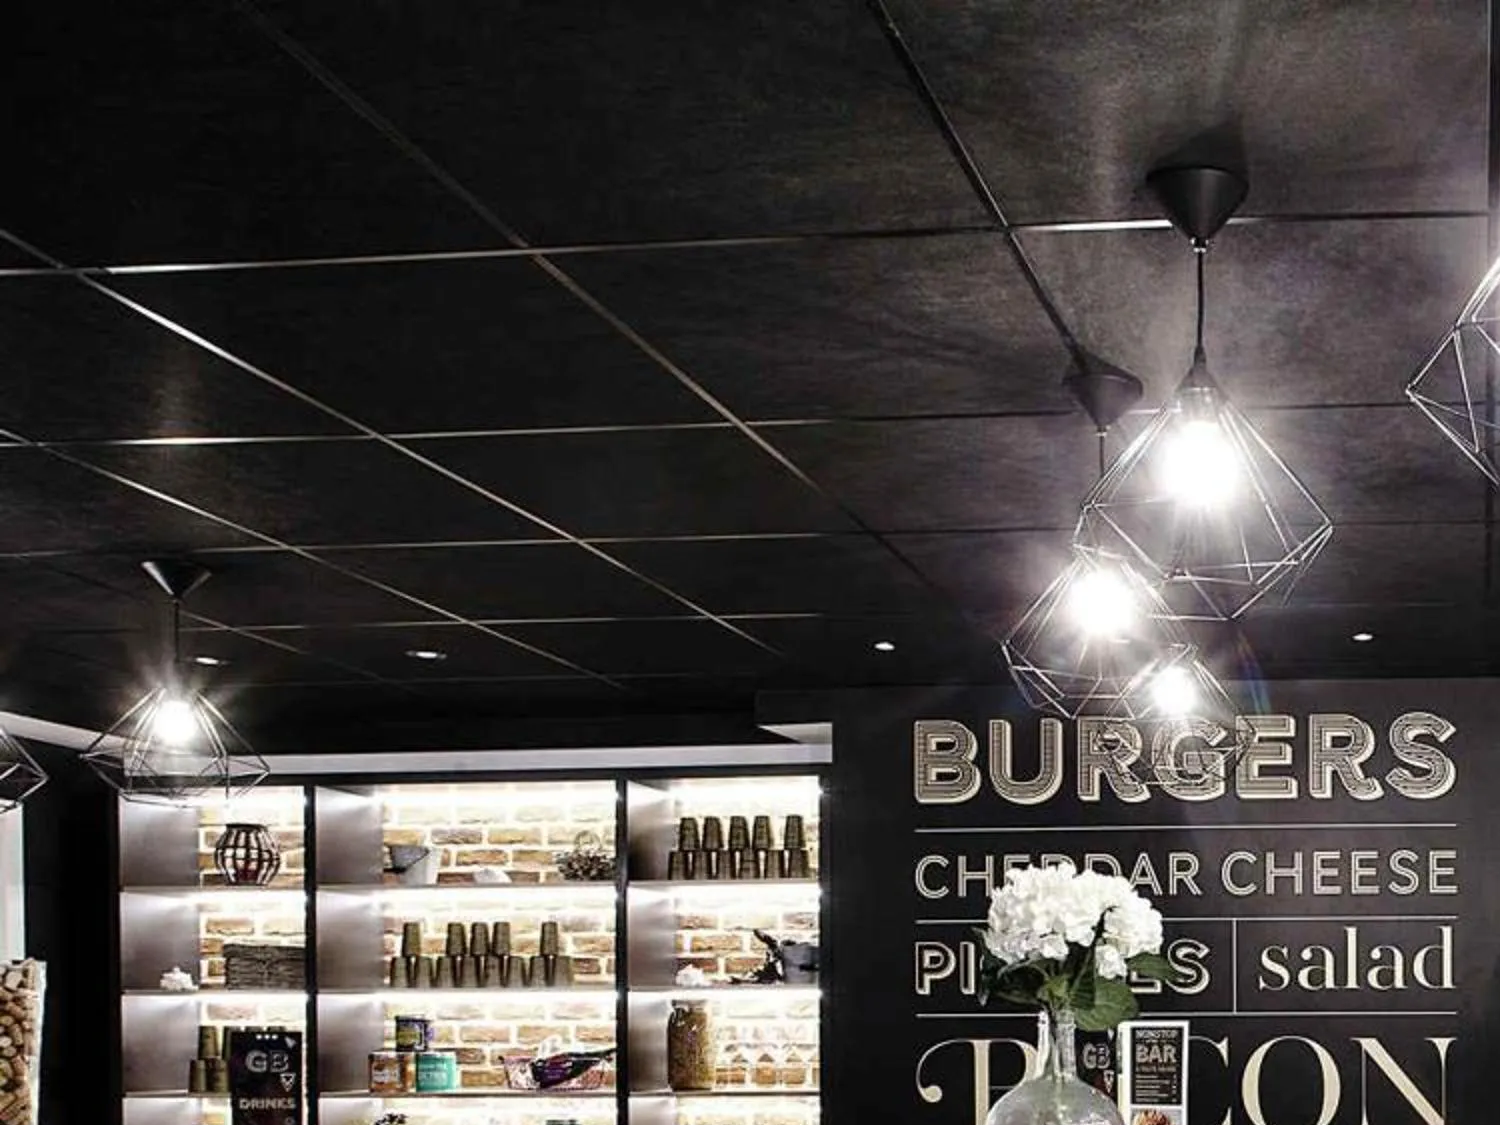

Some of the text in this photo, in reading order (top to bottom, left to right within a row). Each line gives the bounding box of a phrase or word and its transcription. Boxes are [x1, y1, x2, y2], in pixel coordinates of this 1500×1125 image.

[914, 711, 1457, 804] BURGERS
[915, 849, 1458, 899] CHAR CHEESE
[1258, 925, 1456, 991] salad
[1135, 1043, 1177, 1063] BAR
